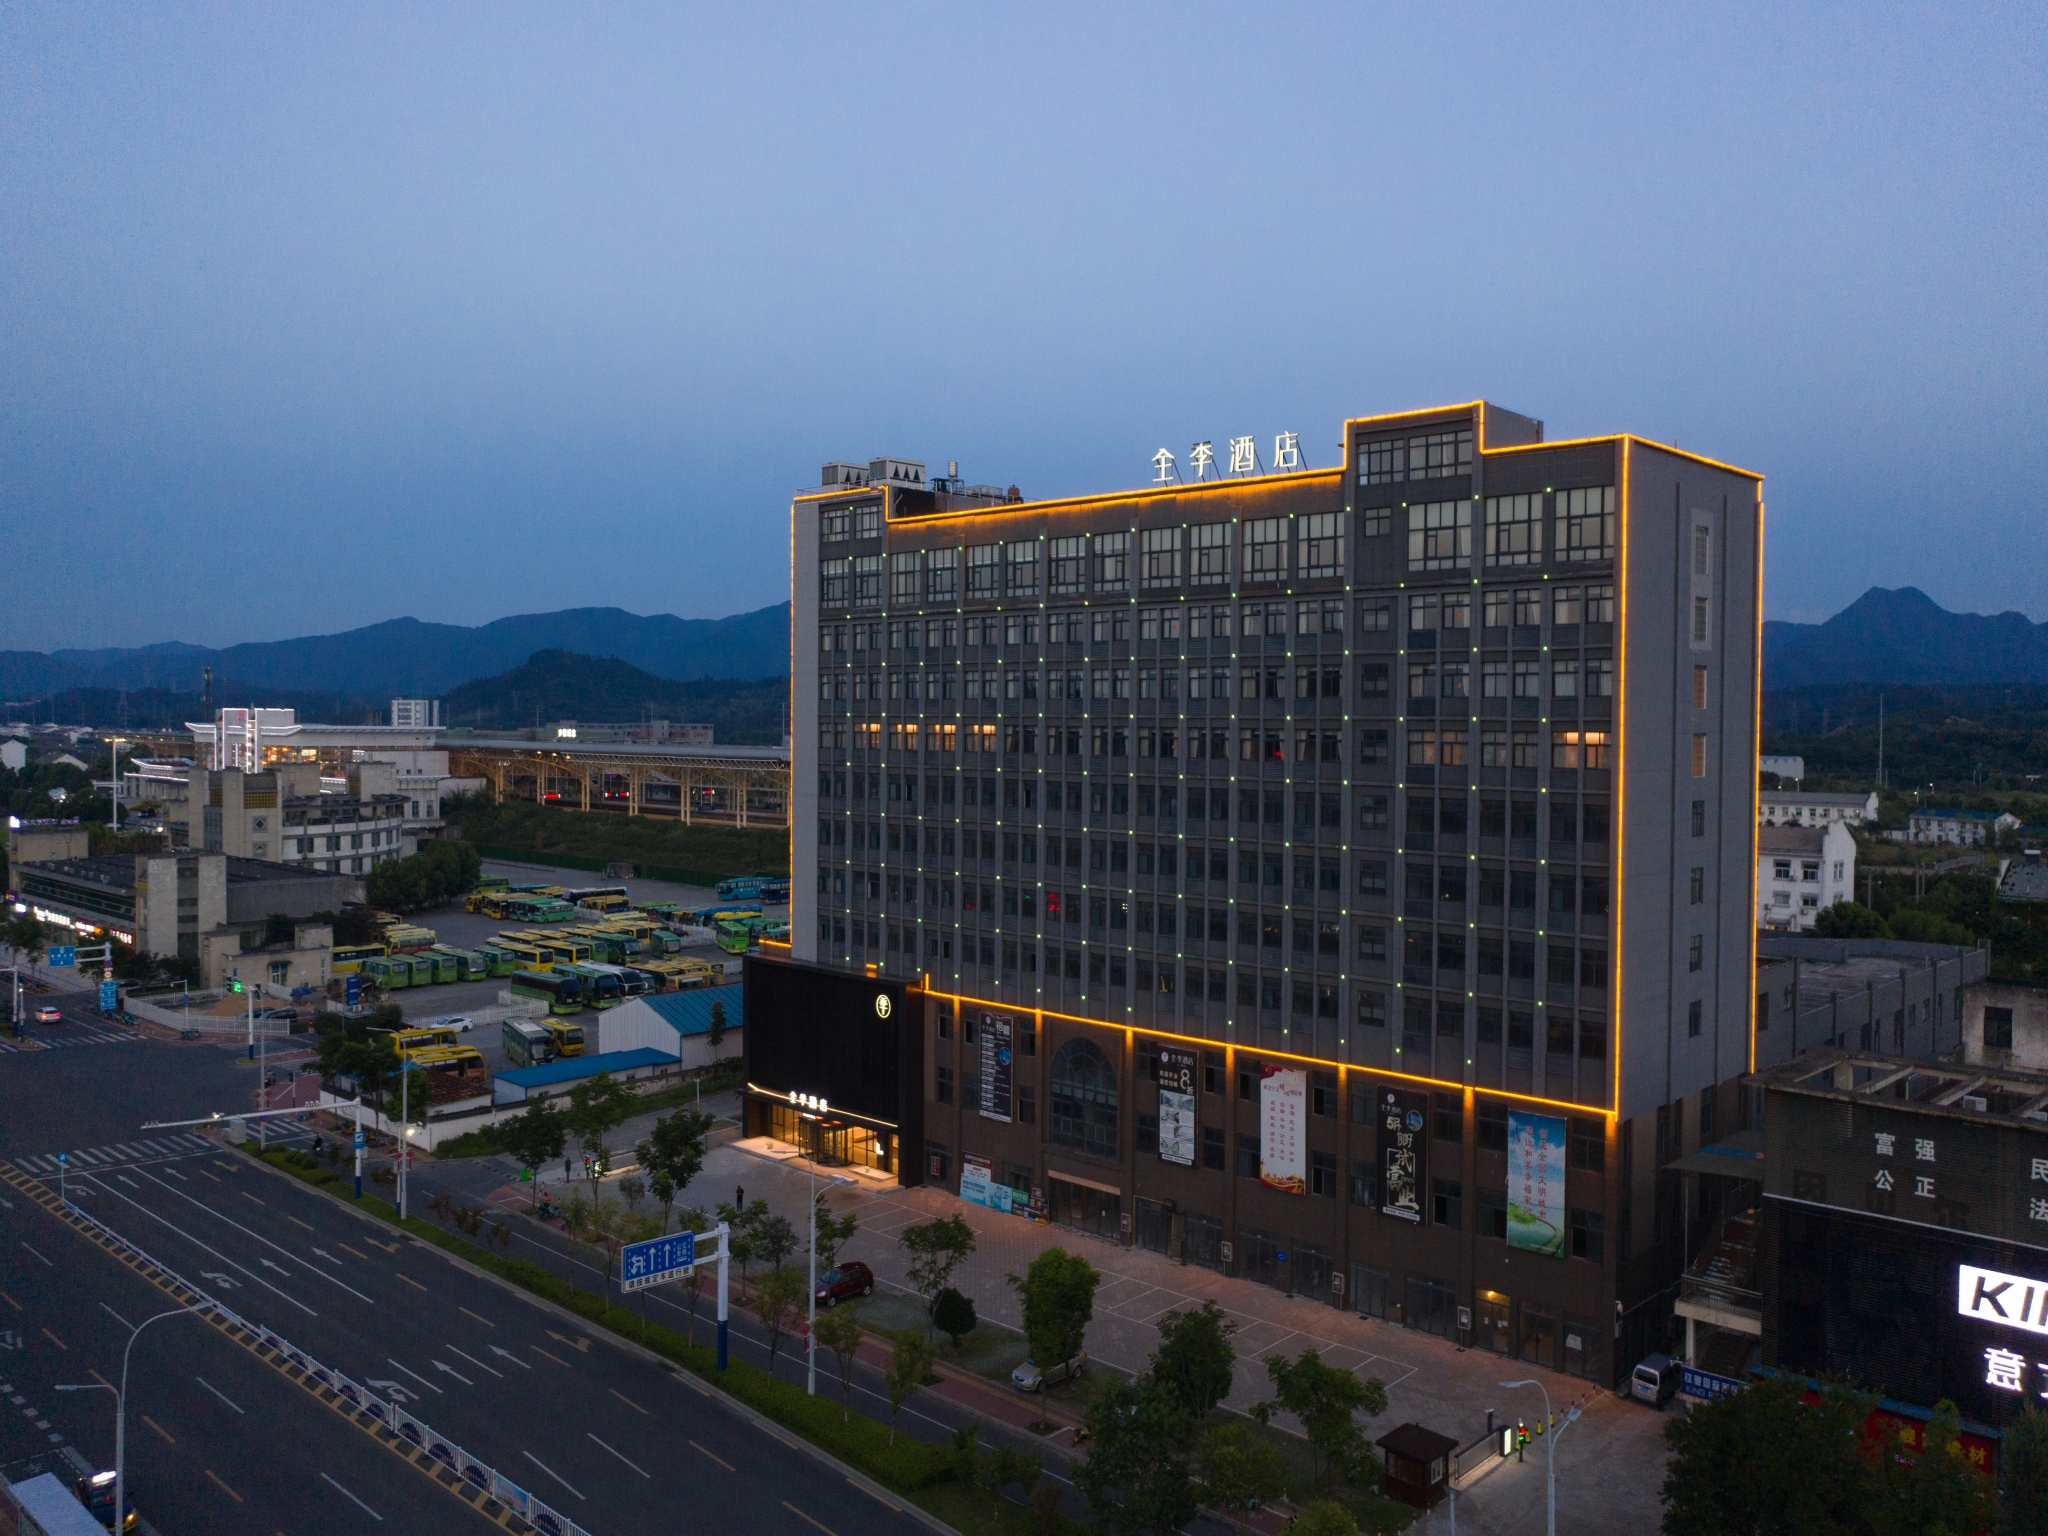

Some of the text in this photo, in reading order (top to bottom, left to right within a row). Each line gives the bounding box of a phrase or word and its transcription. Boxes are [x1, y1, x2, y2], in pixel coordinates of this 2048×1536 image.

[1151, 430, 1299, 483] 全季酒店
[1170, 1054, 1194, 1066] 全季酒店
[1874, 1132, 1937, 1162] 富强
[1537, 1127, 1549, 1220] 创建全国文明城市
[1874, 1169, 1937, 1199] 公正
[628, 1266, 690, 1289] 请按规定车道行驶
